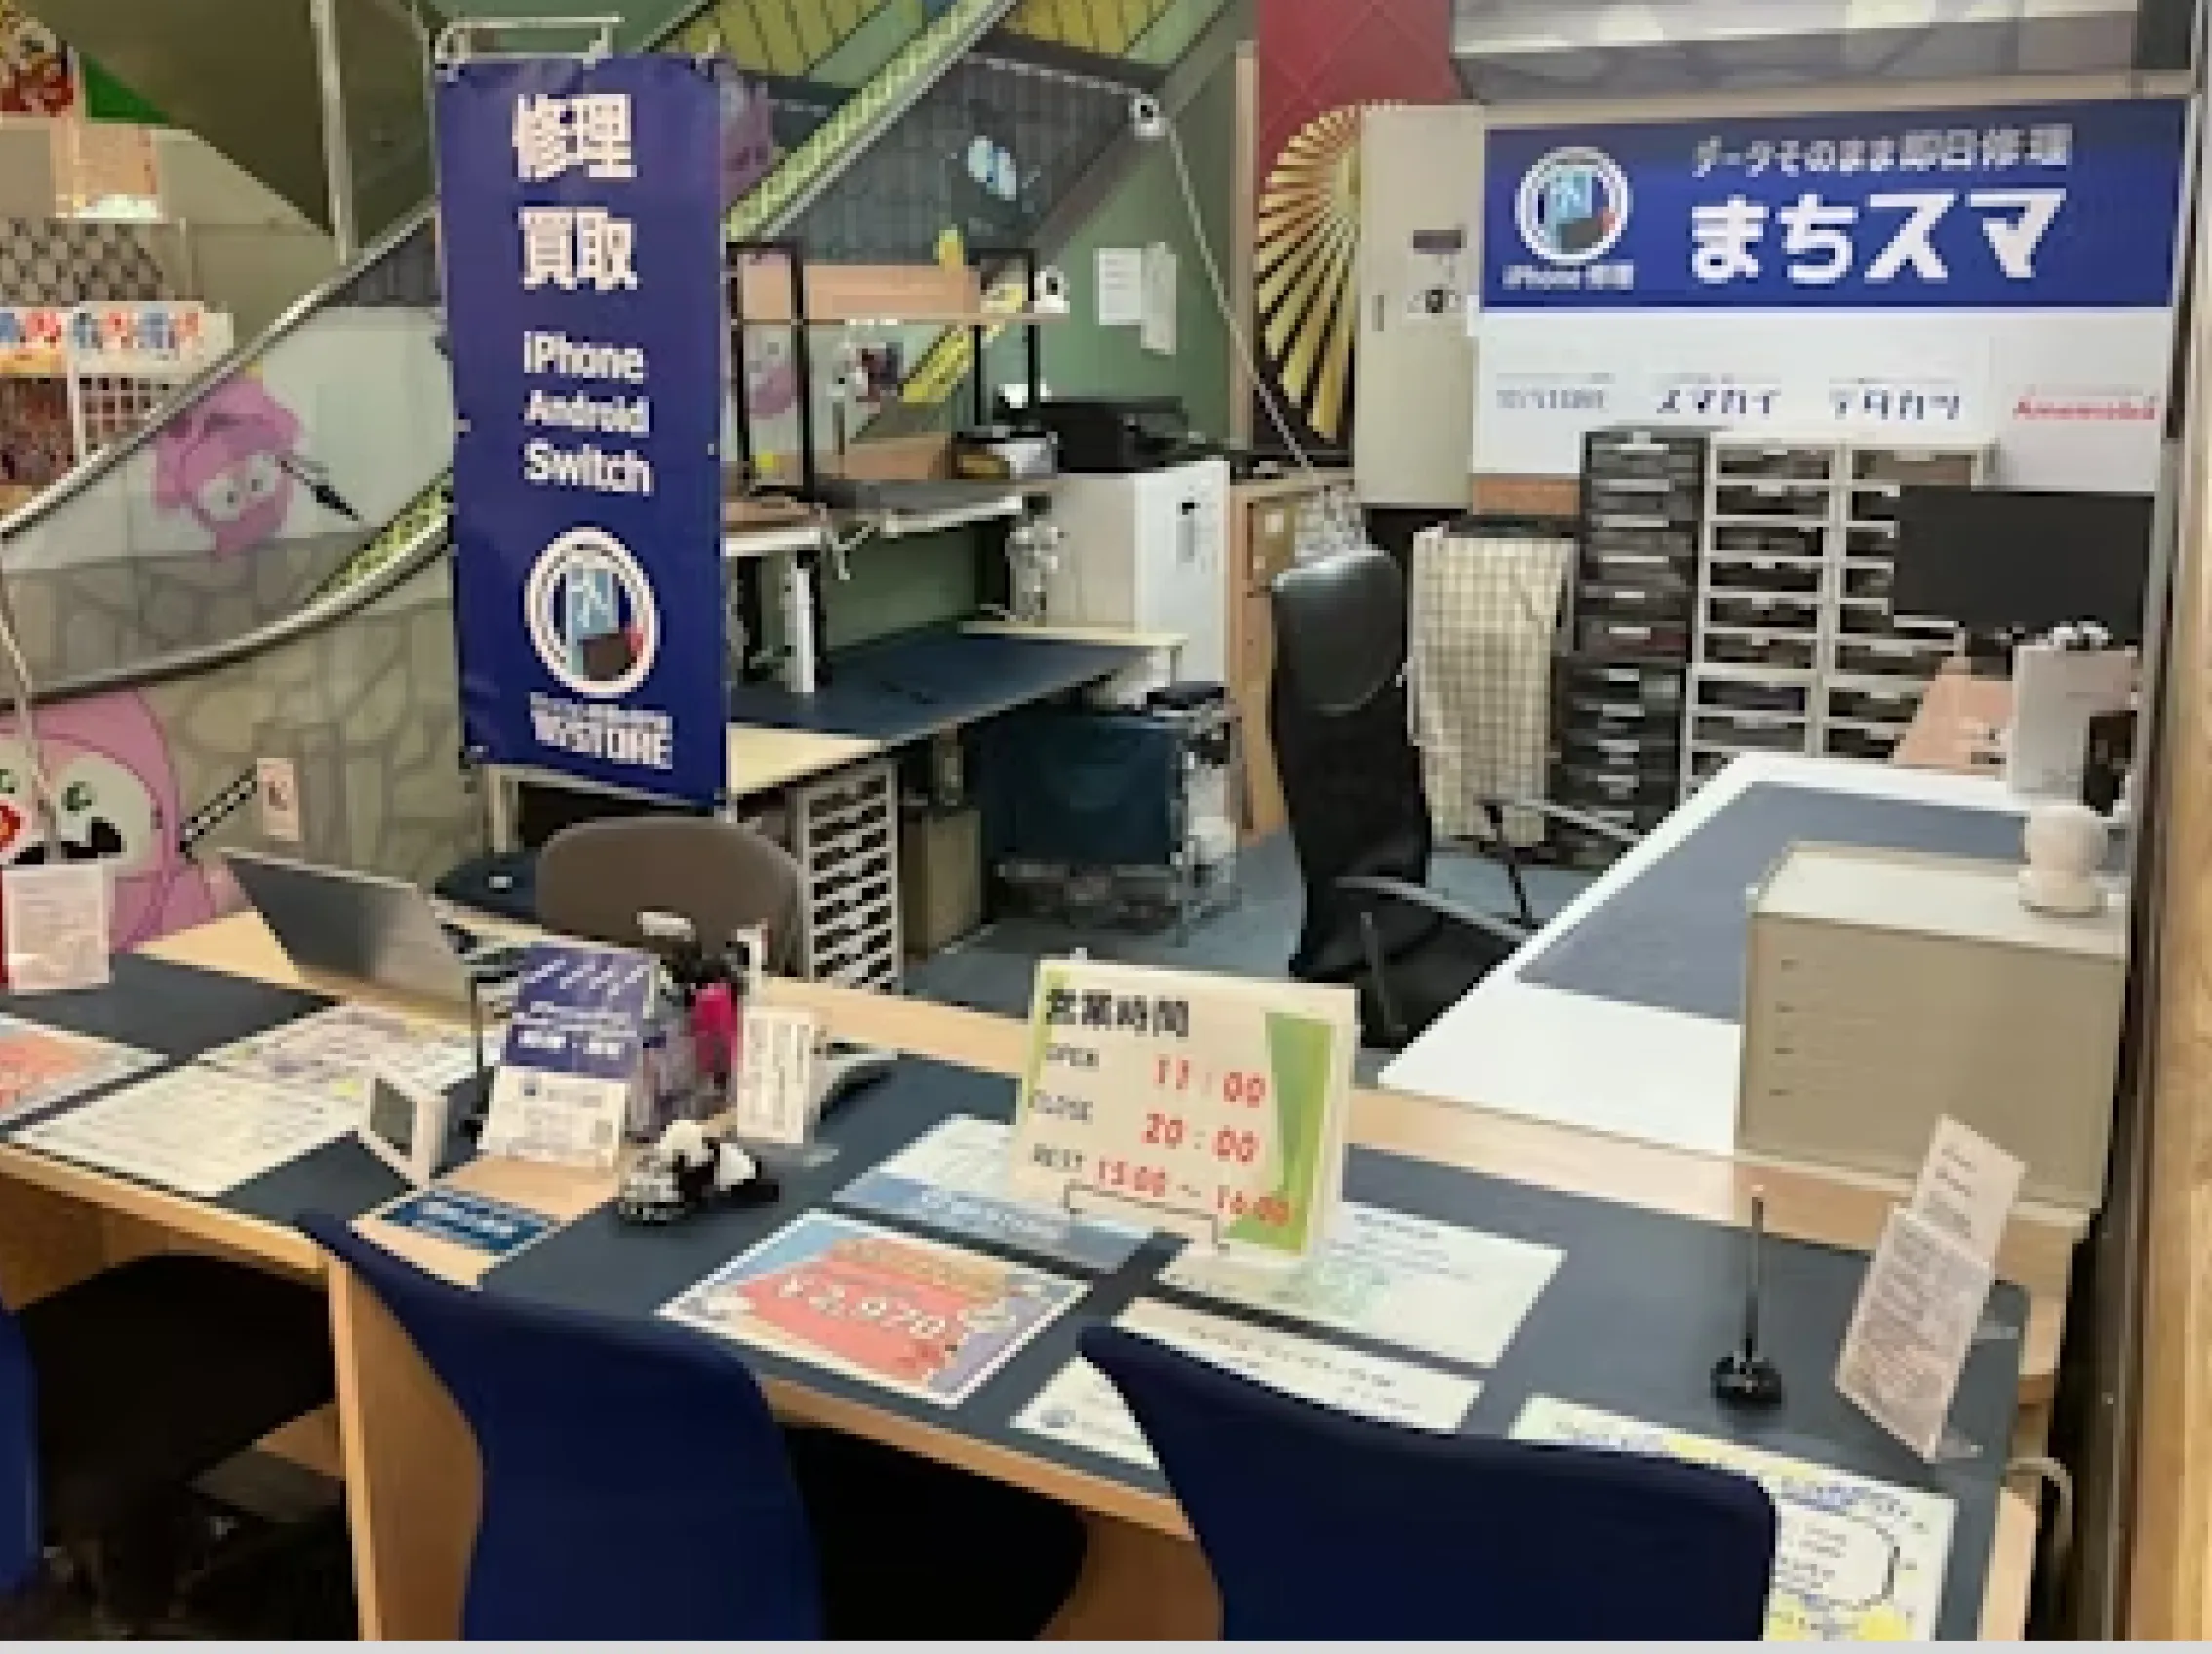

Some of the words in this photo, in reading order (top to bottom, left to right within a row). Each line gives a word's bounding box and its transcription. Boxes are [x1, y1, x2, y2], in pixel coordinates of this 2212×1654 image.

[512, 93, 637, 182] 修理
[518, 207, 637, 291] 買取
[1690, 187, 2067, 284] まちスマ
[523, 330, 645, 383] iPhone
[523, 389, 649, 437] Android
[523, 438, 654, 496] Switch
